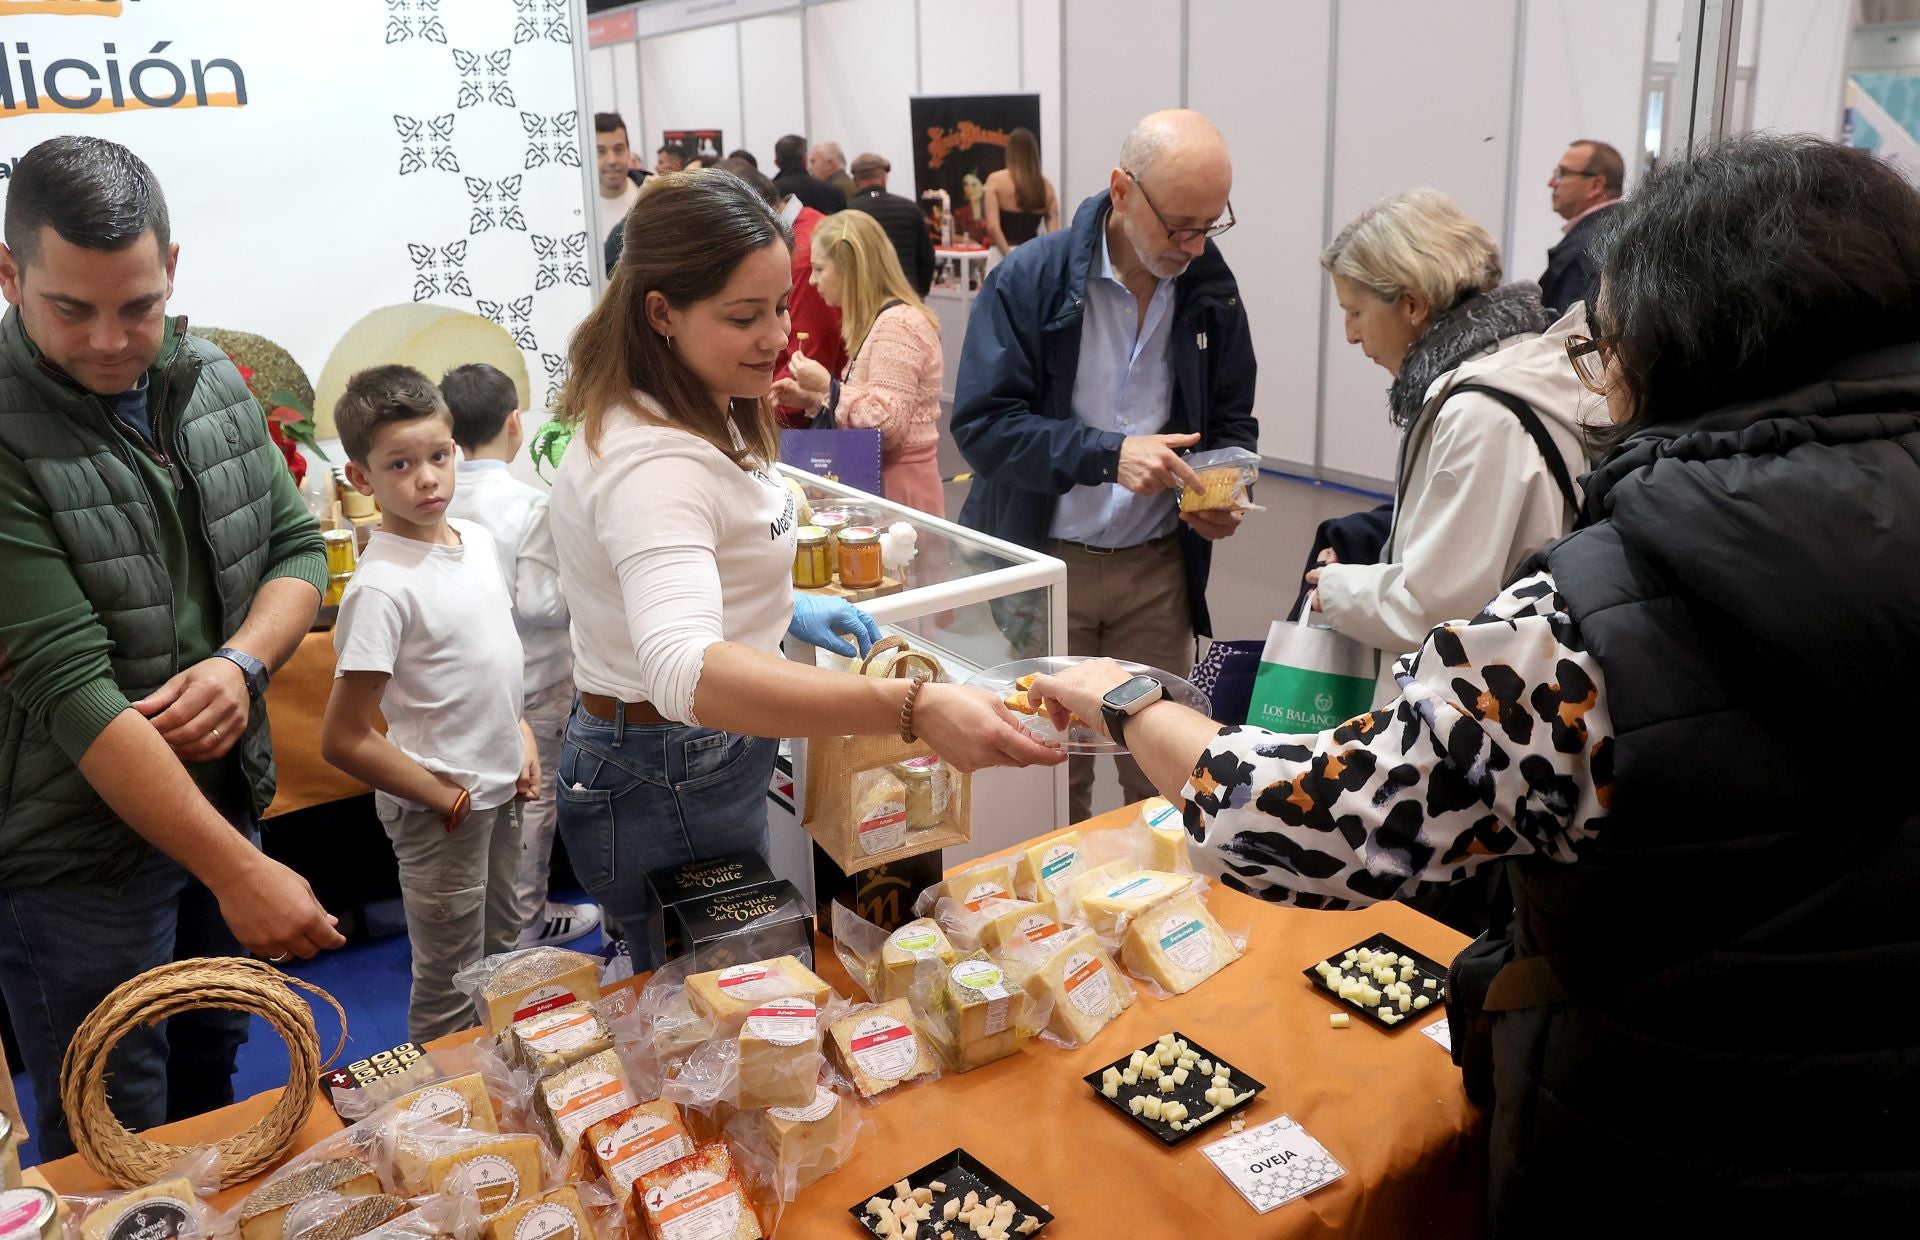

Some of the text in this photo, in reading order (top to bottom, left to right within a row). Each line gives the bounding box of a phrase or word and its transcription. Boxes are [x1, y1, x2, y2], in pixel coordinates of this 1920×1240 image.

[1262, 703, 1284, 717] LOS
[674, 862, 744, 884] Marqués
[695, 871, 744, 889] Valle
[706, 893, 778, 917] Marqués
[715, 903, 778, 922] del Valle
[536, 1002, 553, 1013] Añejo
[578, 1091, 602, 1105] Curado
[630, 1137, 655, 1152] Curado
[1250, 1150, 1298, 1174] OVEJA
[682, 1194, 709, 1209] Curado
